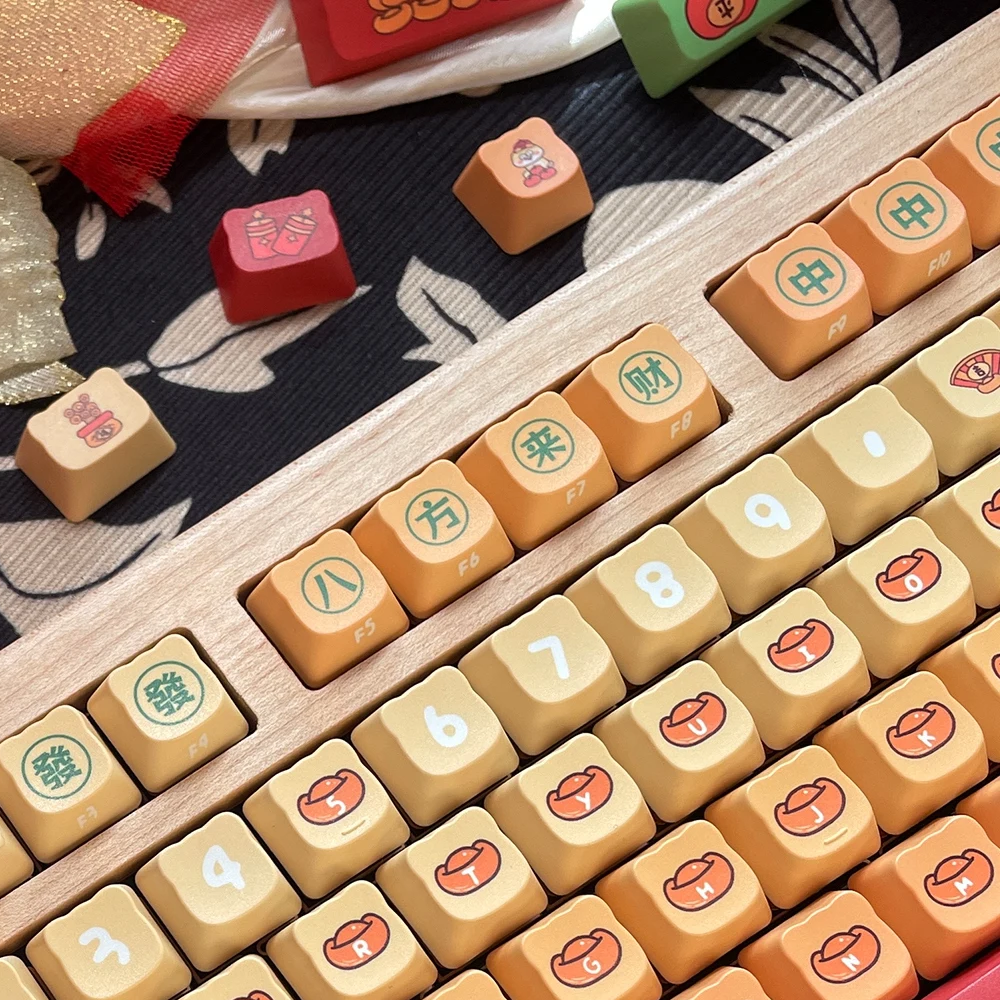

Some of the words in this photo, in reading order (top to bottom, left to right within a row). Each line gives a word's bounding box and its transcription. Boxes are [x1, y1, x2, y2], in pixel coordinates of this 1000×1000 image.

[888, 192, 935, 230] 中
[787, 258, 836, 296] 中
[927, 250, 951, 277] F10
[828, 314, 847, 340] F9
[623, 356, 675, 401] 财
[670, 410, 693, 440] F8
[520, 425, 567, 468] 来
[566, 480, 586, 505] F7
[415, 496, 461, 540] 方
[744, 493, 792, 531] 9
[458, 552, 480, 577] F6
[313, 569, 358, 610] 八
[635, 561, 685, 609] 8
[354, 617, 376, 644] F5
[527, 635, 571, 680] 7
[798, 645, 816, 662] I
[143, 671, 195, 717] 發
[423, 705, 469, 748] 6
[687, 718, 708, 736] U
[917, 730, 936, 747] K
[188, 732, 209, 758] F4
[31, 745, 83, 791] 發
[575, 792, 591, 811] Y
[810, 805, 824, 824] J
[77, 805, 98, 829] F3
[202, 845, 246, 890] 4
[461, 865, 479, 885] T
[695, 882, 714, 900] H
[954, 877, 973, 896] M
[79, 927, 131, 965] 3
[352, 939, 372, 958] R
[583, 957, 601, 974] G
[841, 954, 860, 972] N
